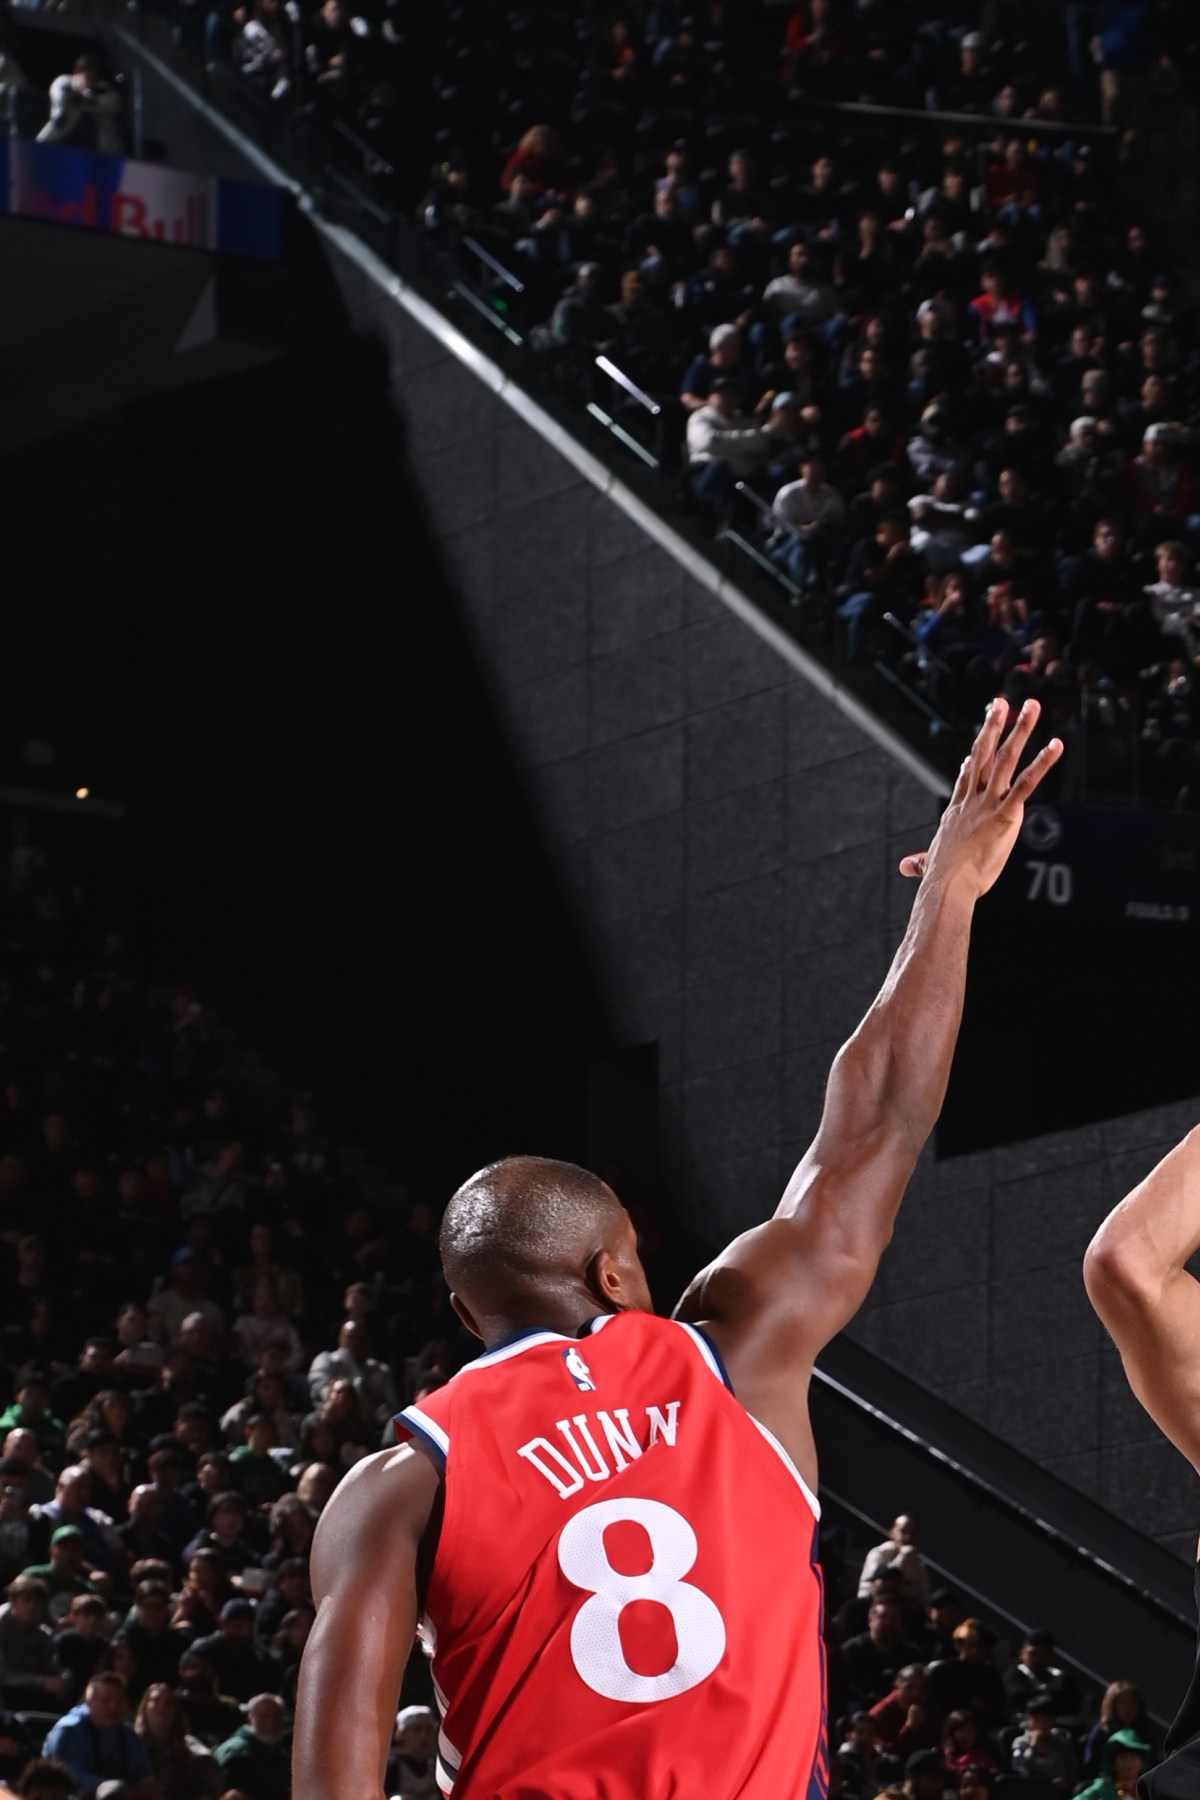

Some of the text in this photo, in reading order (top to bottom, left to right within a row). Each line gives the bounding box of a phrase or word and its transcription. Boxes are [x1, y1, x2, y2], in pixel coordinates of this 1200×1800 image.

[1024, 859, 1073, 905] 70
[516, 1400, 681, 1500] DUNN
[557, 1497, 726, 1704] 8
